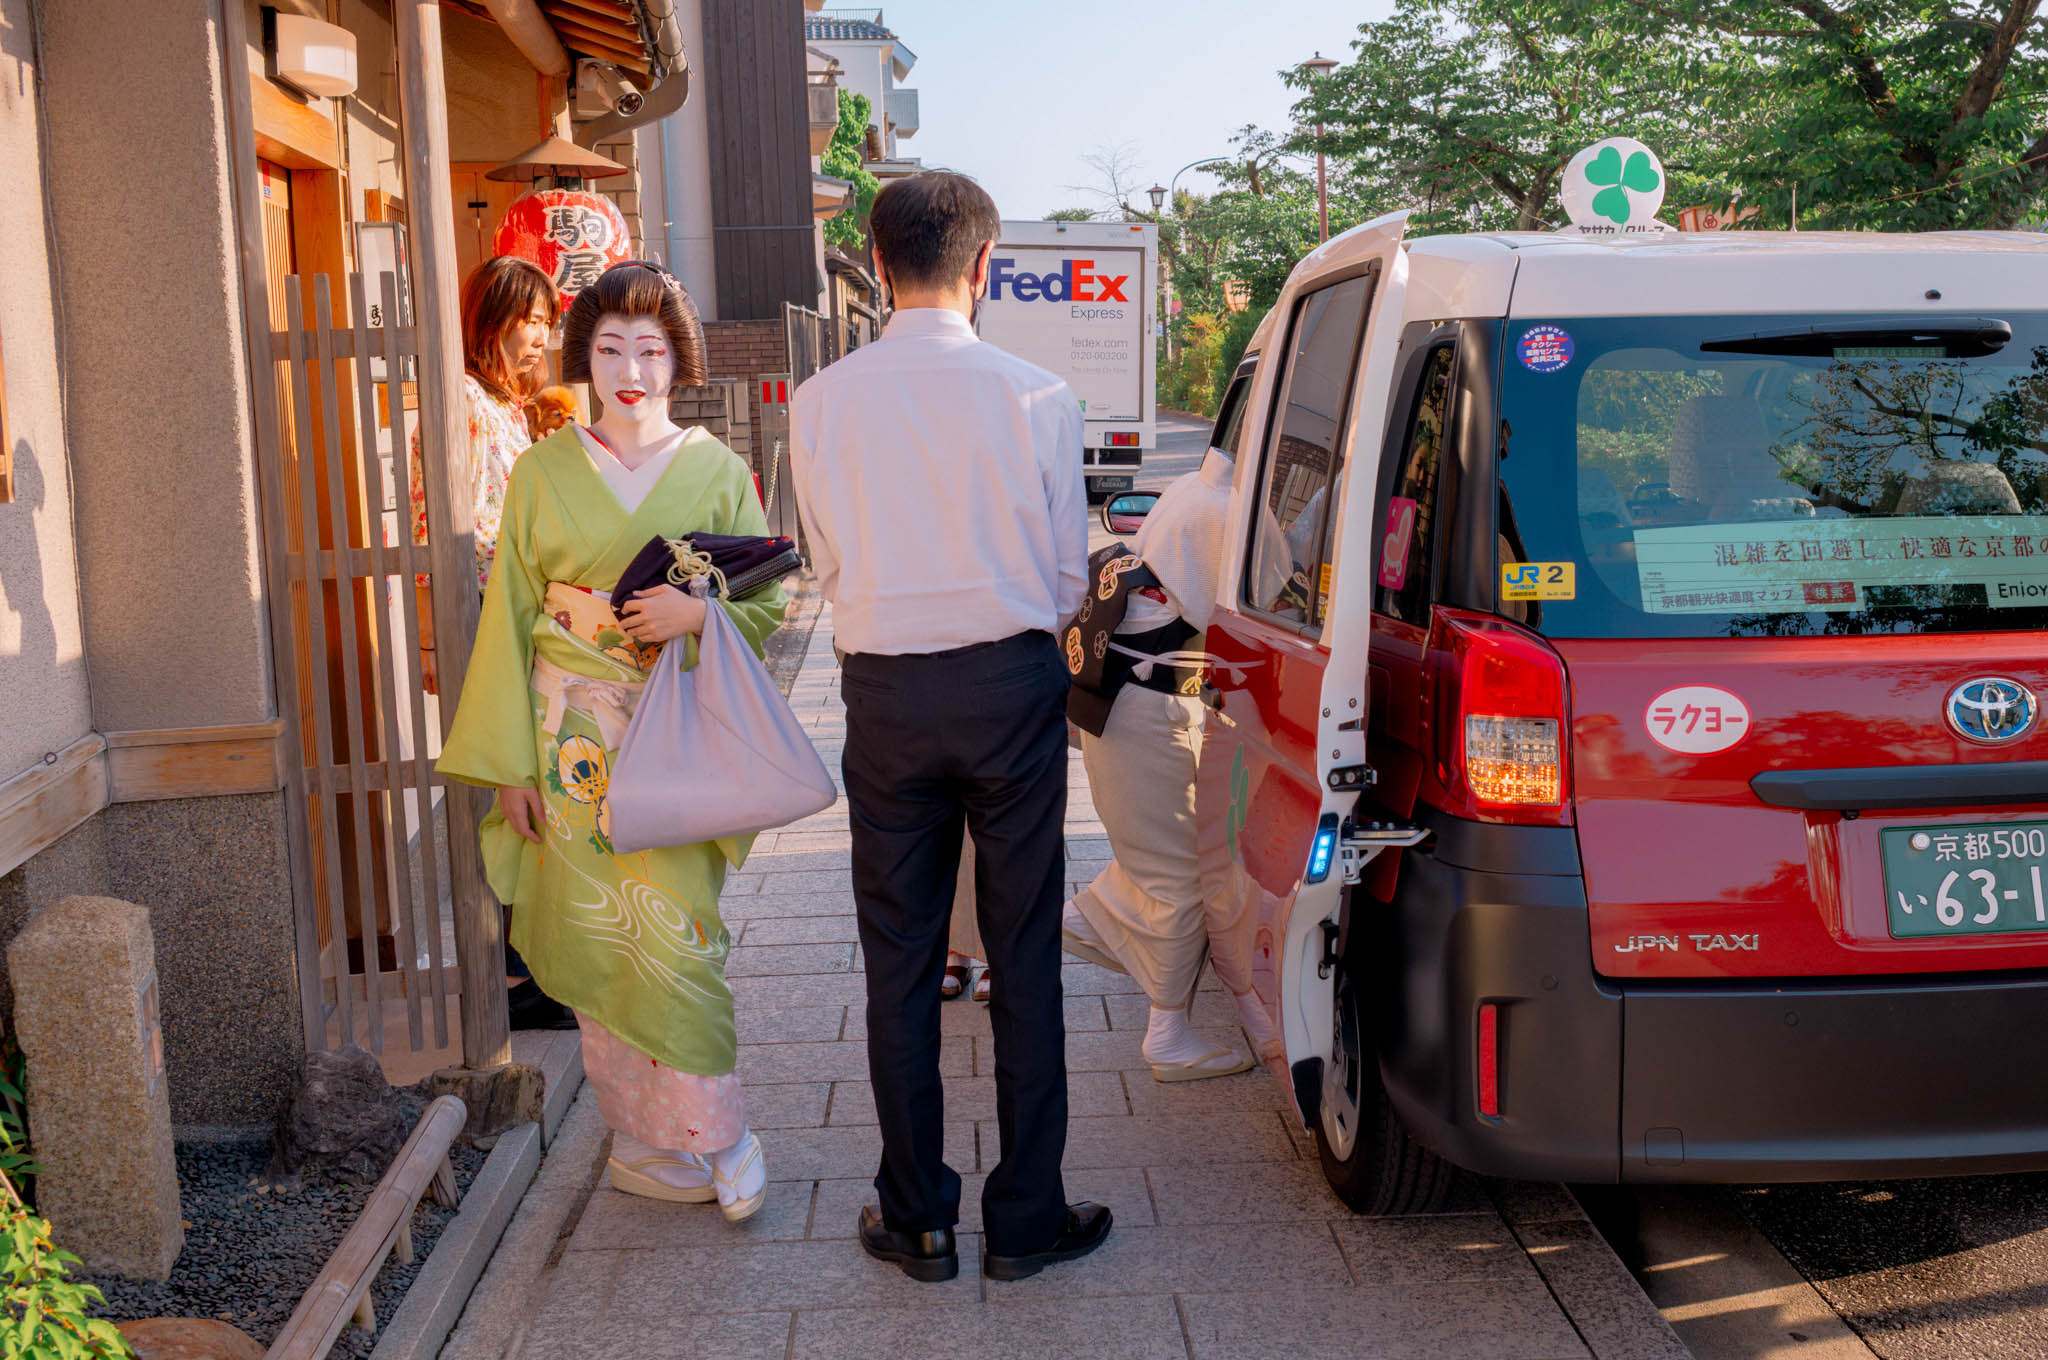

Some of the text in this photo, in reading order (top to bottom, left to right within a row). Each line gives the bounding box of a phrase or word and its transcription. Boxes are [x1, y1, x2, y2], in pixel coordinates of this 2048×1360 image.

[990, 258, 1129, 303] FedEx
[1071, 305, 1124, 321] Express
[1071, 336, 1129, 349] fedex.com
[1505, 565, 1564, 584] JR 2
[1653, 703, 1743, 735] ラクヨー
[1614, 934, 1759, 953] JPN TAXI
